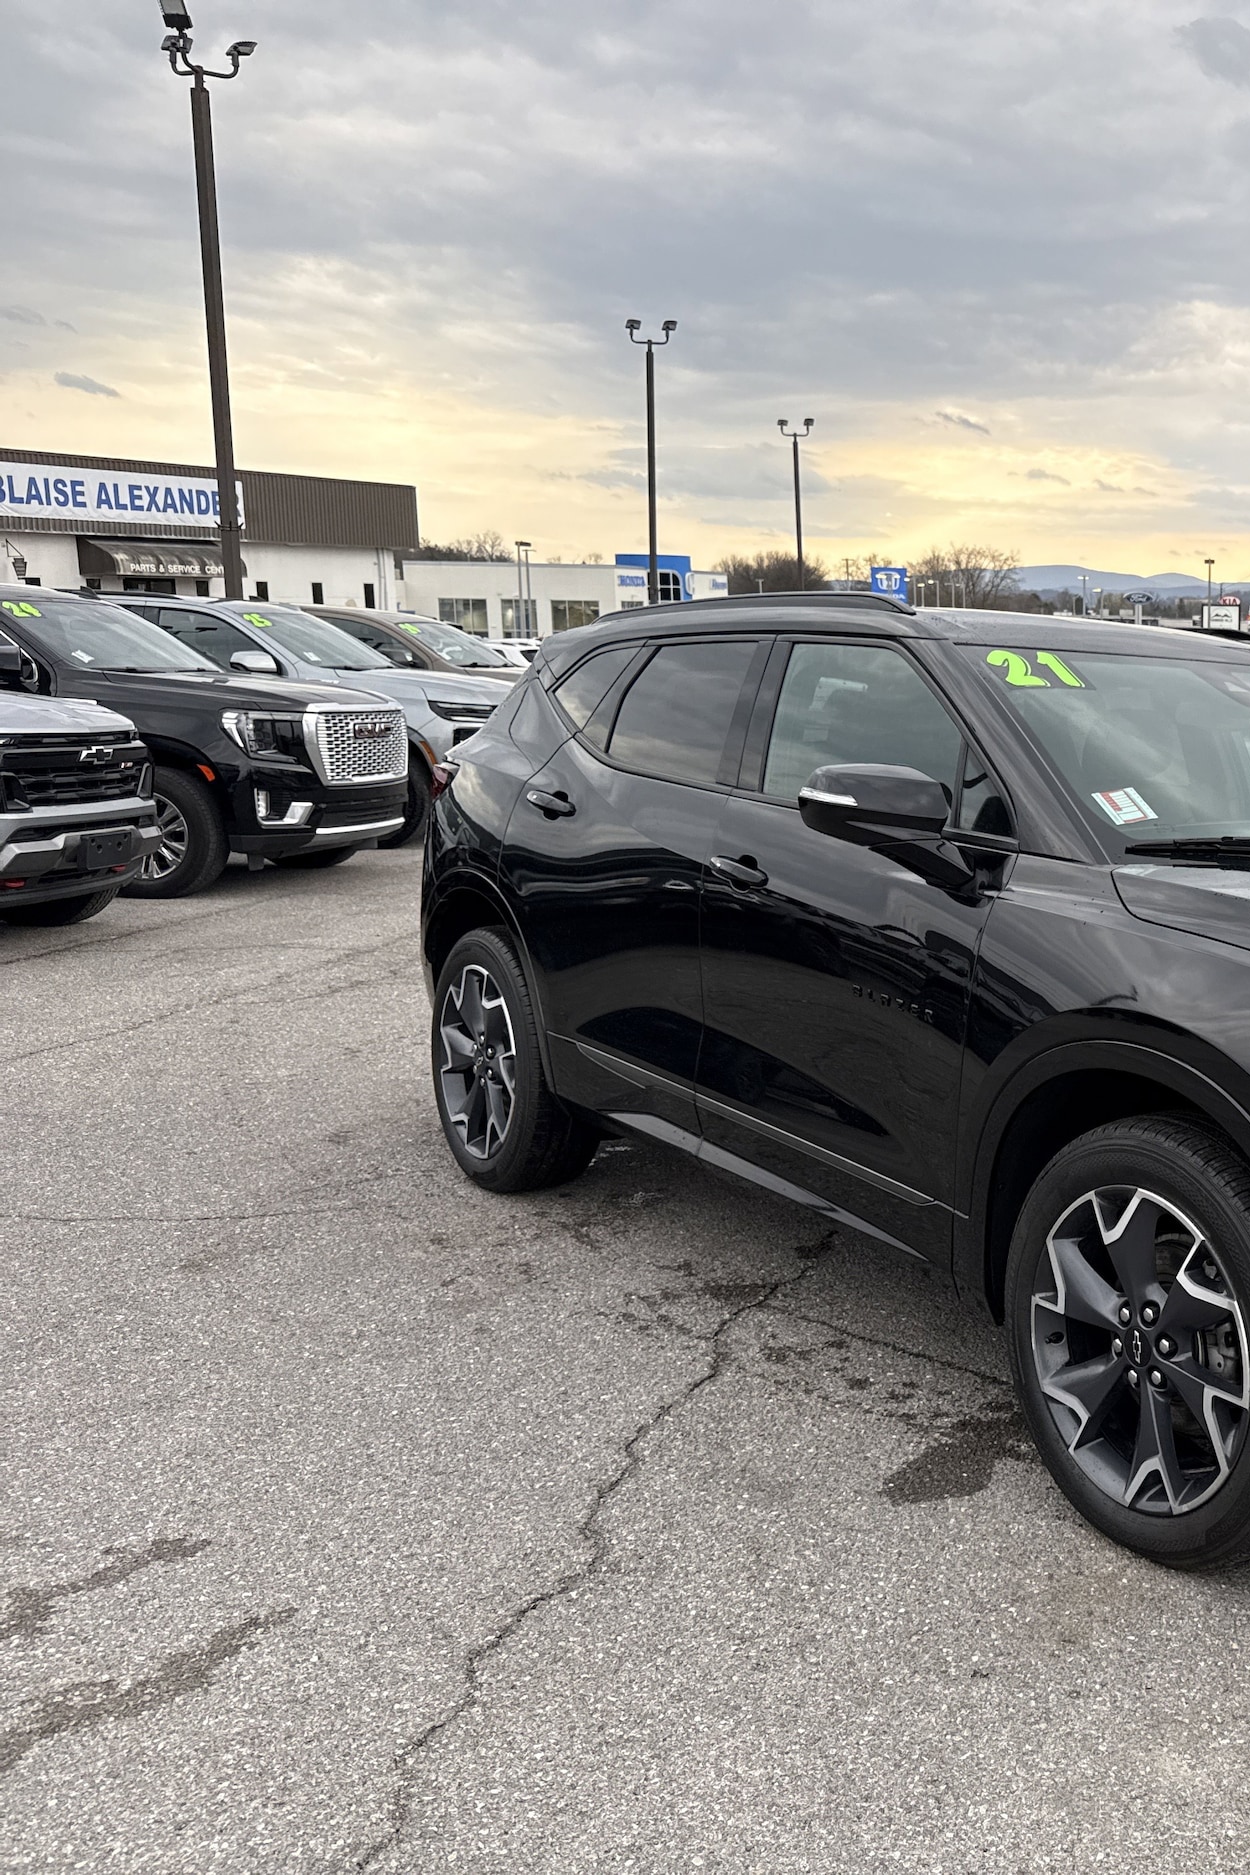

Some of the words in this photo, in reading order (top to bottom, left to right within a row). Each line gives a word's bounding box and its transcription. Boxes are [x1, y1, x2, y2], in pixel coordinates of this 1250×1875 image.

[96, 482, 241, 517] ALEXANDE
[130, 563, 156, 573] PARTS
[159, 564, 165, 573] &
[168, 564, 201, 574] SERVICE
[205, 566, 225, 574] CENT
[243, 613, 272, 628] 25
[986, 649, 1086, 688] 21
[852, 983, 934, 1024] BLAZER
